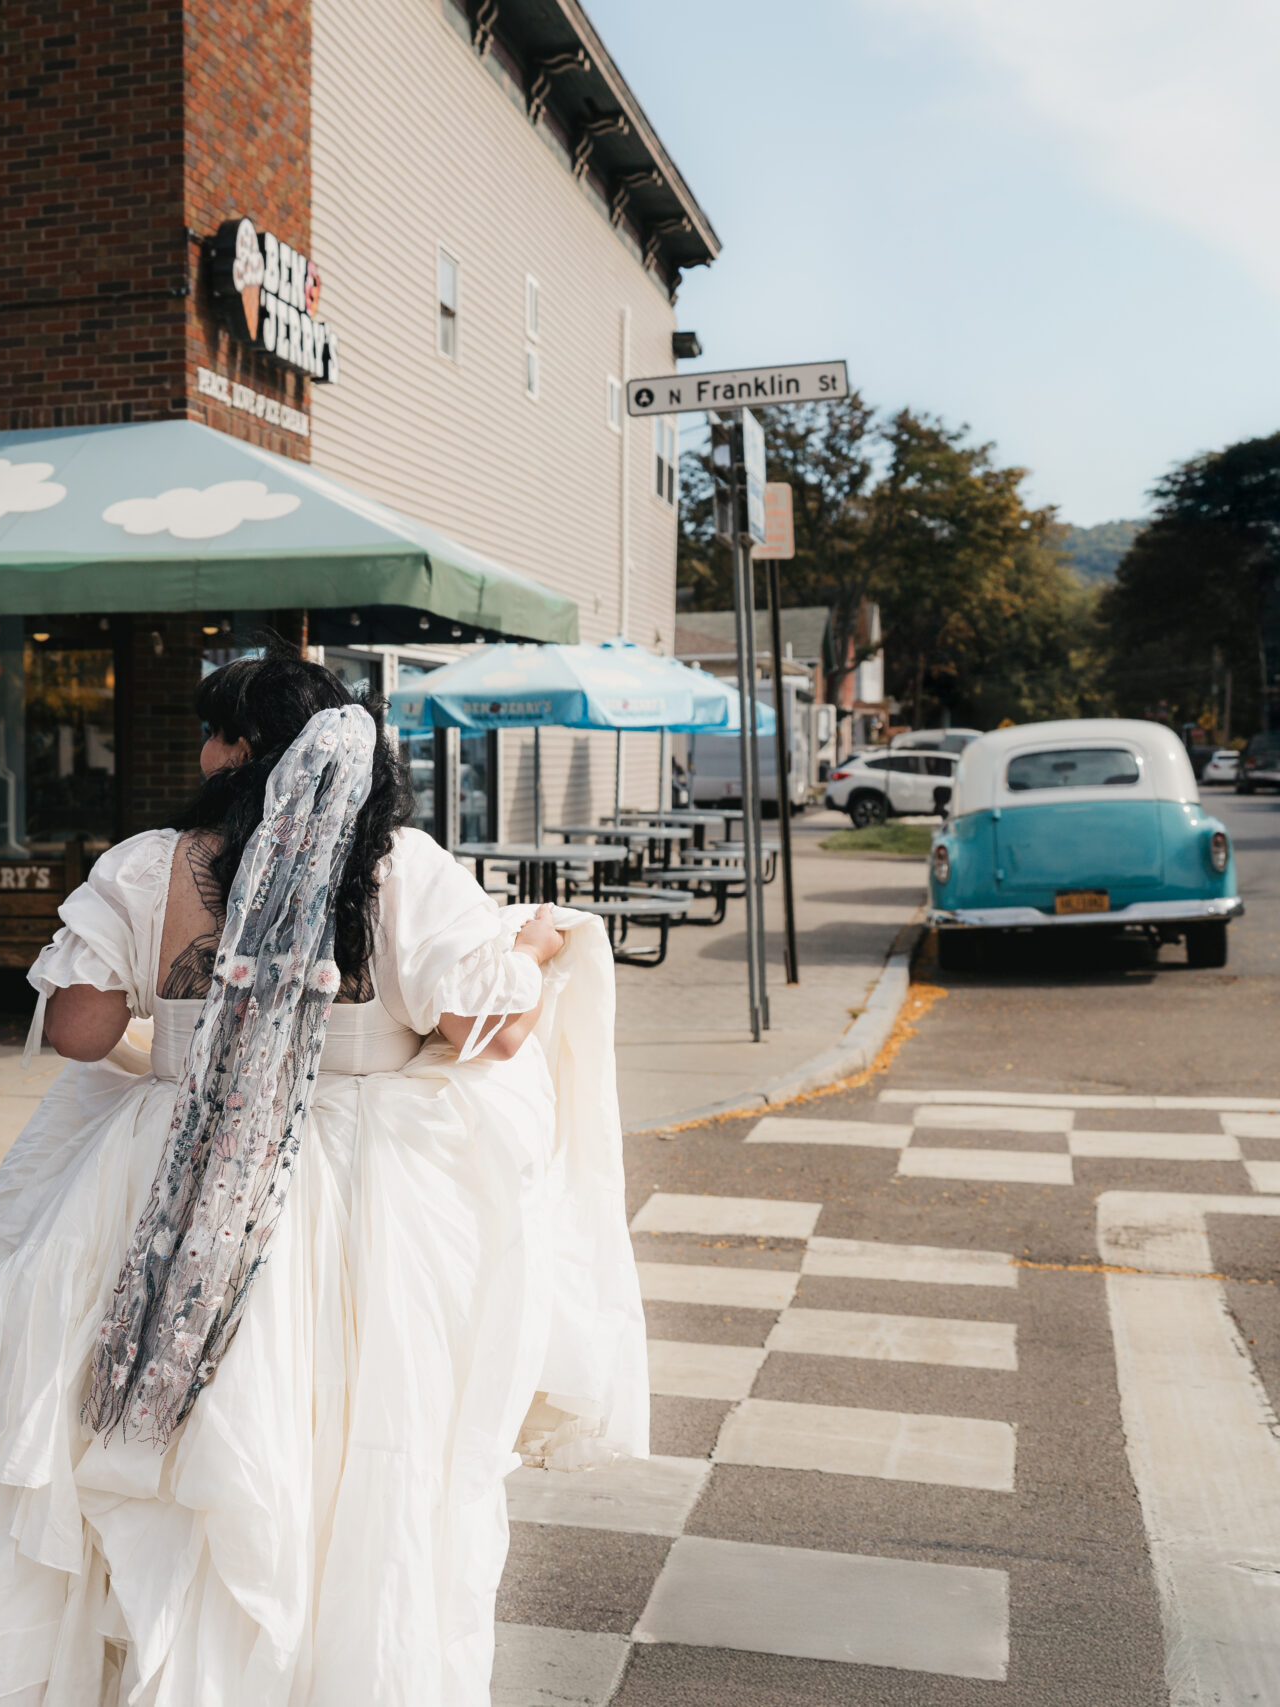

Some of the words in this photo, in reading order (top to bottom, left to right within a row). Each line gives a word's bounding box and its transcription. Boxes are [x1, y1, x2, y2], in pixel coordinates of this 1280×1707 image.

[262, 288, 339, 385] JERRY'S
[668, 388, 682, 405] N
[696, 373, 801, 402] Franklin
[818, 374, 838, 392] St
